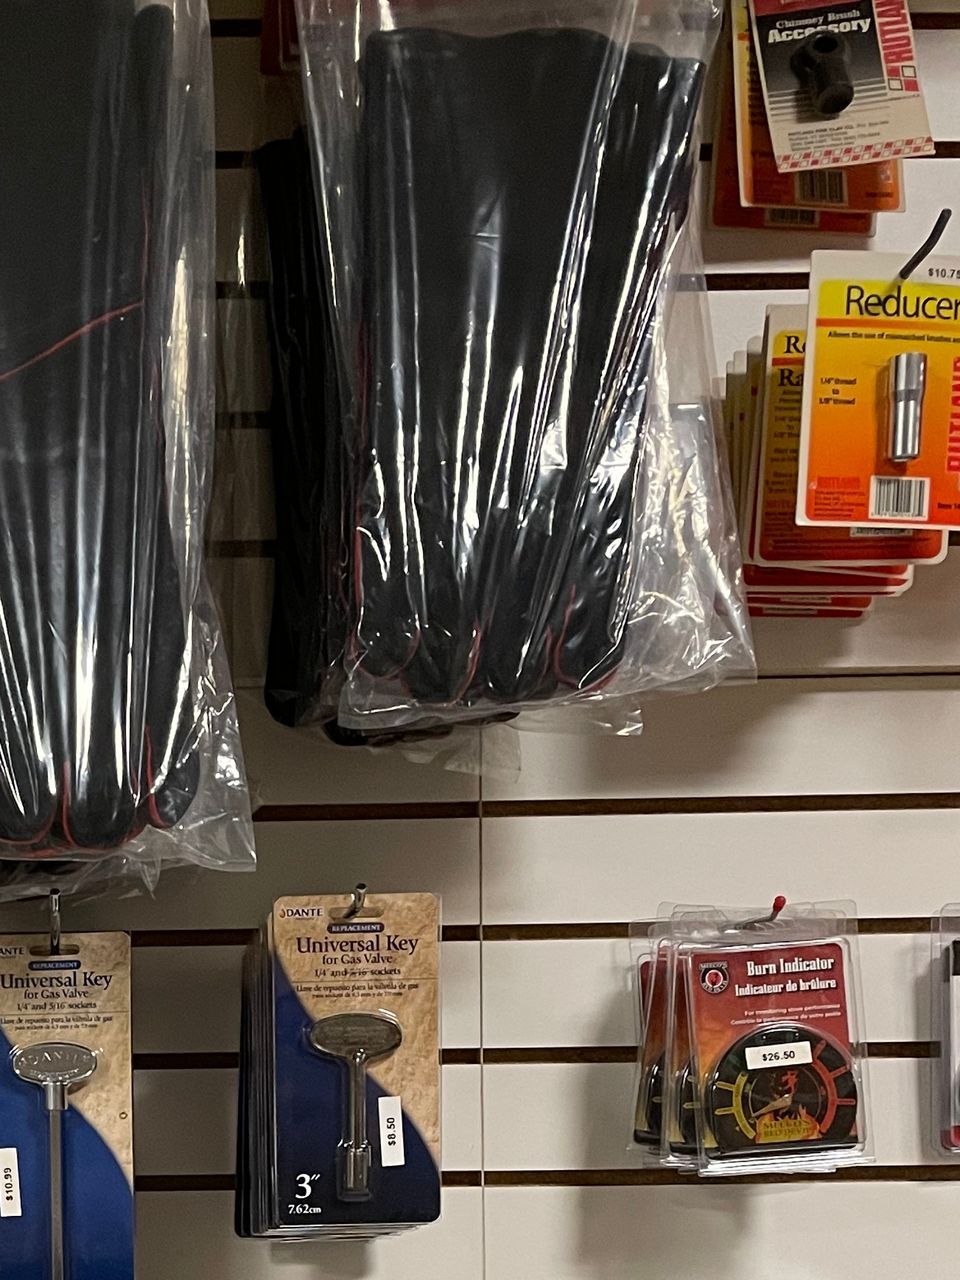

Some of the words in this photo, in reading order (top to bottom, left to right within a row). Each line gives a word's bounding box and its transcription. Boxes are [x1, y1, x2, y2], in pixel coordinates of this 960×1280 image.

[775, 14, 824, 29] Chimney
[827, 9, 861, 21] Brush
[286, 908, 323, 918] DANTE
[296, 935, 380, 954] Universal
[386, 934, 419, 955] Key
[322, 953, 338, 965] for
[341, 953, 362, 965] Gas
[364, 952, 393, 964] Valve
[747, 961, 776, 976] Burn
[780, 957, 834, 974] Indicator
[0, 973, 77, 989] Universal
[82, 971, 113, 990] Key
[330, 968, 346, 977] and
[24, 989, 39, 1000] for
[40, 989, 61, 1000] Gas
[63, 988, 89, 998] Valve
[735, 983, 784, 997] Indicateur
[786, 980, 798, 992] de
[799, 977, 836, 991] brûlure
[31, 1002, 47, 1010] and
[762, 1051, 795, 1061] $26.50
[386, 1117, 396, 1146] $8.50
[3, 1167, 13, 1202] $10.99
[288, 1204, 322, 1214] 7.62cm
